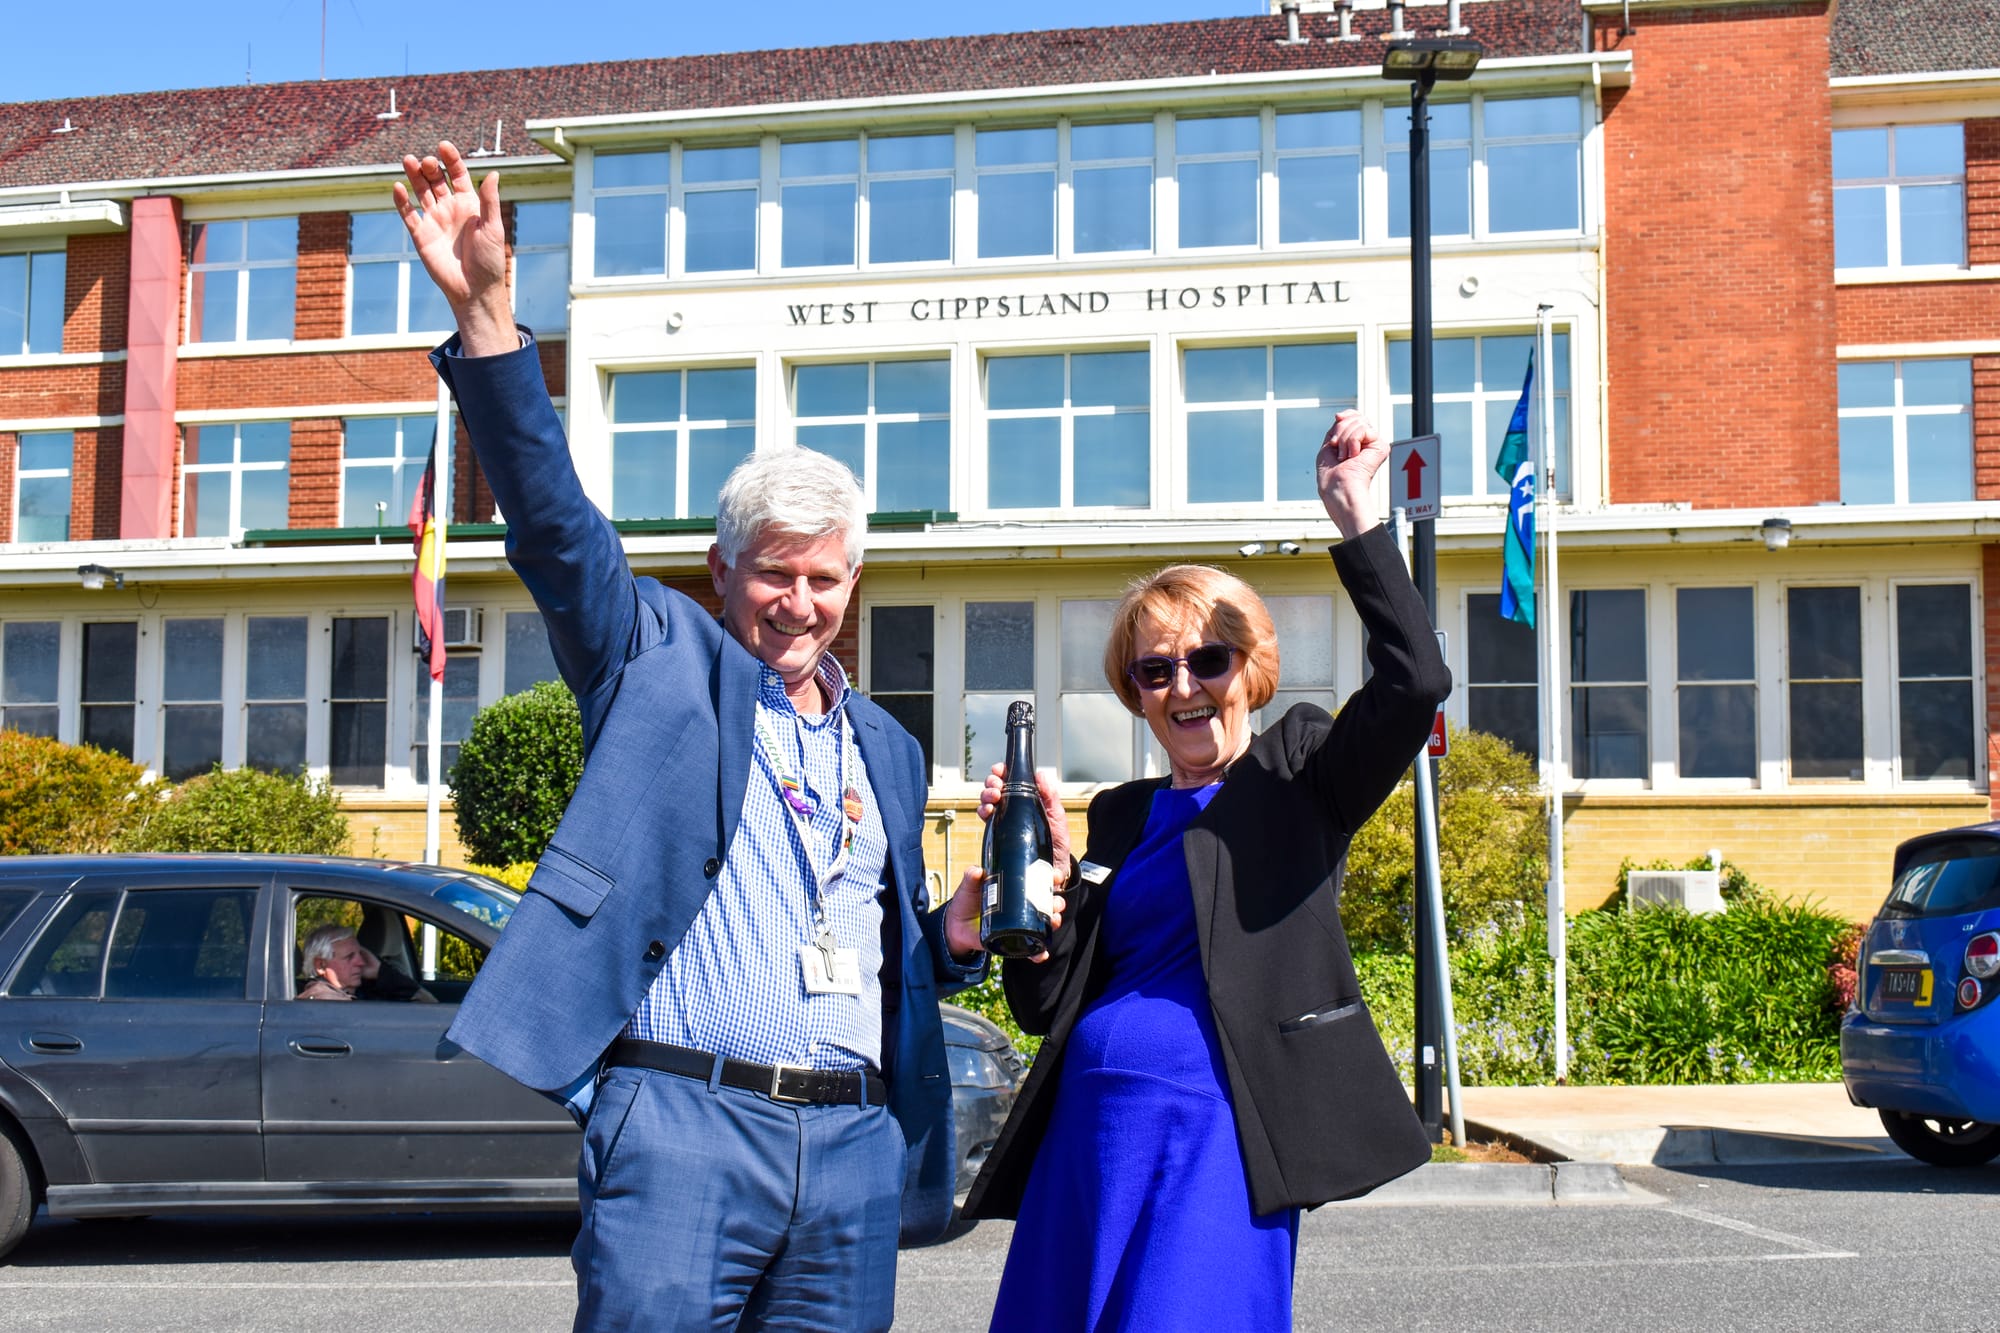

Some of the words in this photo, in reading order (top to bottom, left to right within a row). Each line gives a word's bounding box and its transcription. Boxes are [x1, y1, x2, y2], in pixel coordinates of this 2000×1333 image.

[787, 301, 879, 325] WEST
[910, 291, 1109, 321] GIPPSLAND
[1147, 281, 1351, 311] HOSPITAL
[1415, 503, 1433, 514] WAY
